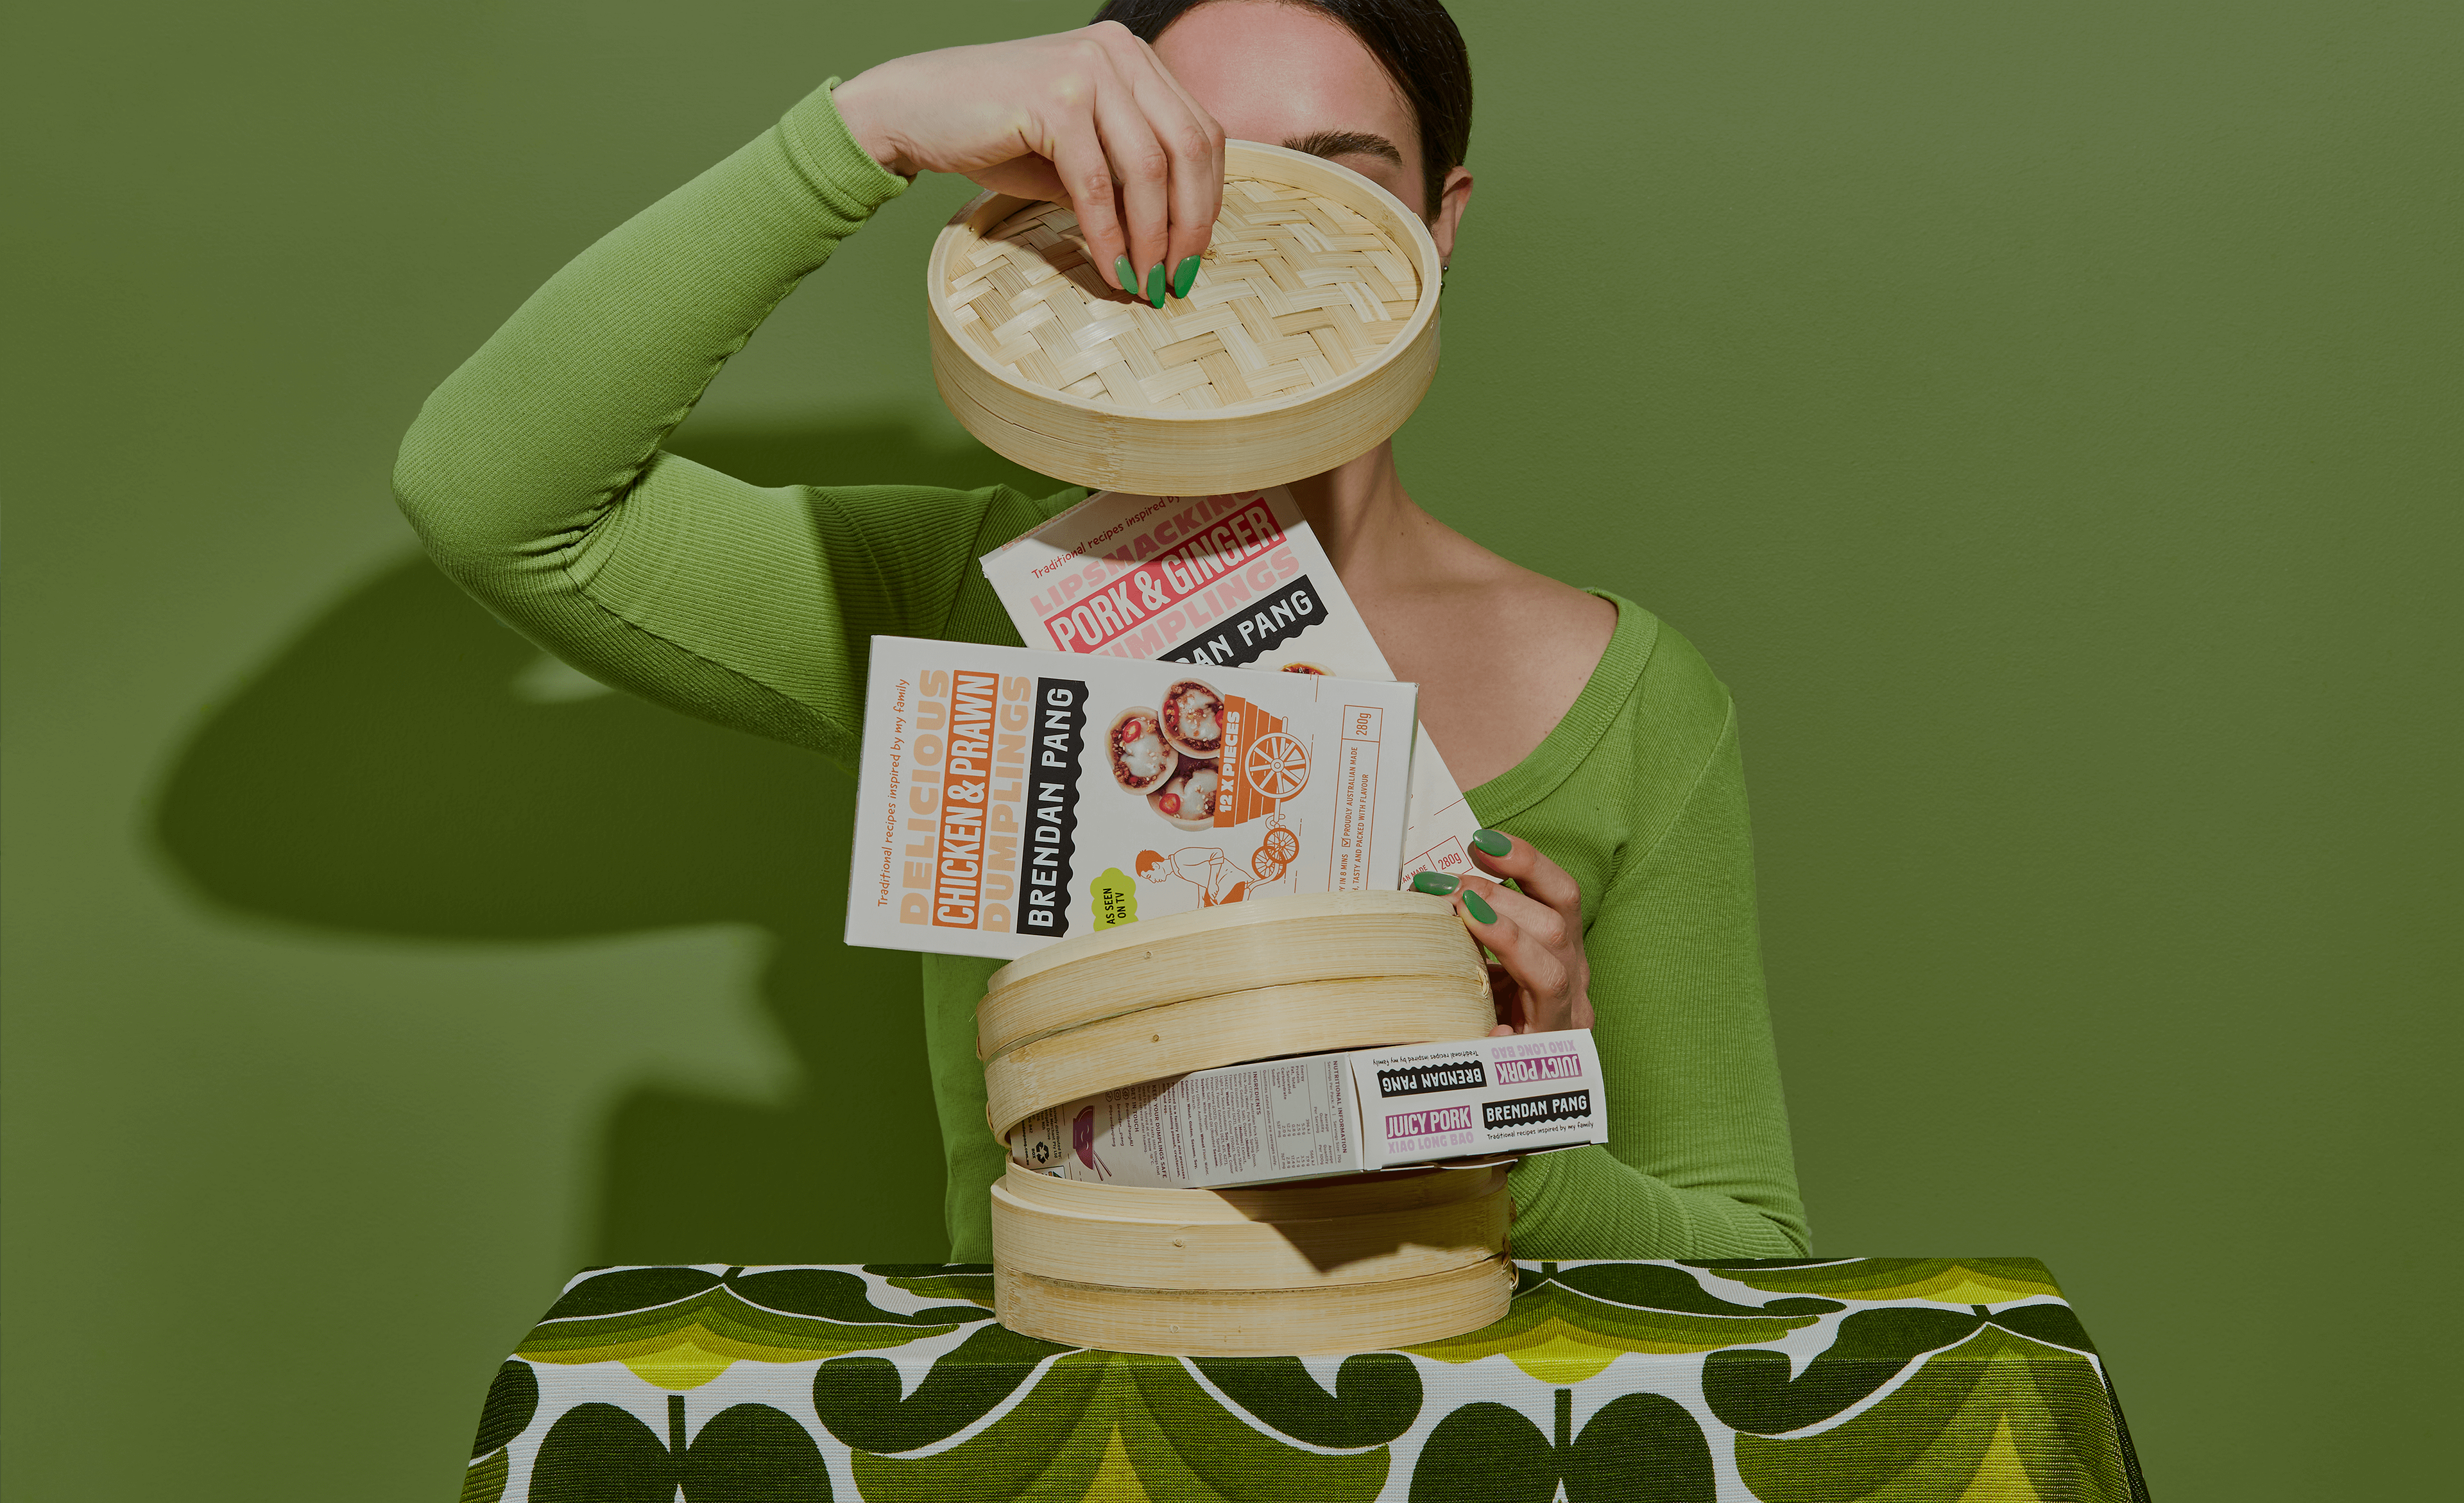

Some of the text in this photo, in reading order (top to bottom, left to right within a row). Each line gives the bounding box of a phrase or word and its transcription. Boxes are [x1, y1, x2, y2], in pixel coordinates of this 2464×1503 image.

[1031, 542, 1086, 578] Traditional
[1088, 523, 1124, 548] recipes
[1125, 497, 1166, 527] inspired
[1050, 581, 1145, 651] PORK
[1134, 571, 1171, 610] &
[1161, 506, 1281, 594] GINGER
[1098, 546, 1299, 659] MPLINGS
[1237, 590, 1313, 647] PANG
[1356, 712, 1371, 735] 280g
[1219, 712, 1240, 812] 12 X PIECES
[877, 678, 910, 906] Traditional recipes inspired by my family
[900, 670, 950, 925] DELICIOUS
[937, 675, 995, 924] CHICKEN & PRAWN
[982, 676, 1031, 932] DUMPLINGS
[1346, 766, 1356, 806] AUSTRALIAN
[1029, 688, 1074, 926] BRENDAN PANG
[1344, 807, 1352, 836] PROUDLY
[1356, 822, 1364, 846] PACKED
[1360, 773, 1368, 802] FLAVOUR
[1438, 852, 1462, 870] 280g
[1103, 888, 1115, 924] AS SEEN
[1115, 893, 1126, 918] ON TV
[1407, 1054, 1429, 1063] inspired
[1451, 1050, 1478, 1059] Traditional
[1491, 1040, 1577, 1060] XIAO LONG BAO
[1498, 1056, 1579, 1083] JUICY PORK
[1253, 1071, 1261, 1115] INGREDIENTS
[1383, 1069, 1482, 1092] BRENDAN PANG
[1125, 1102, 1133, 1146] BrendanPangAU
[1333, 1060, 1347, 1153] NUTRITIONAL INFORMATION
[1387, 1107, 1472, 1138] JUICY PORK
[1487, 1095, 1587, 1122] BRENDAN PANG
[1155, 1122, 1164, 1160] DUMPLINGS
[1388, 1131, 1474, 1154] XIAO LONG BAO
[1487, 1130, 1515, 1140] Traditional
[1537, 1125, 1558, 1133] inspired
